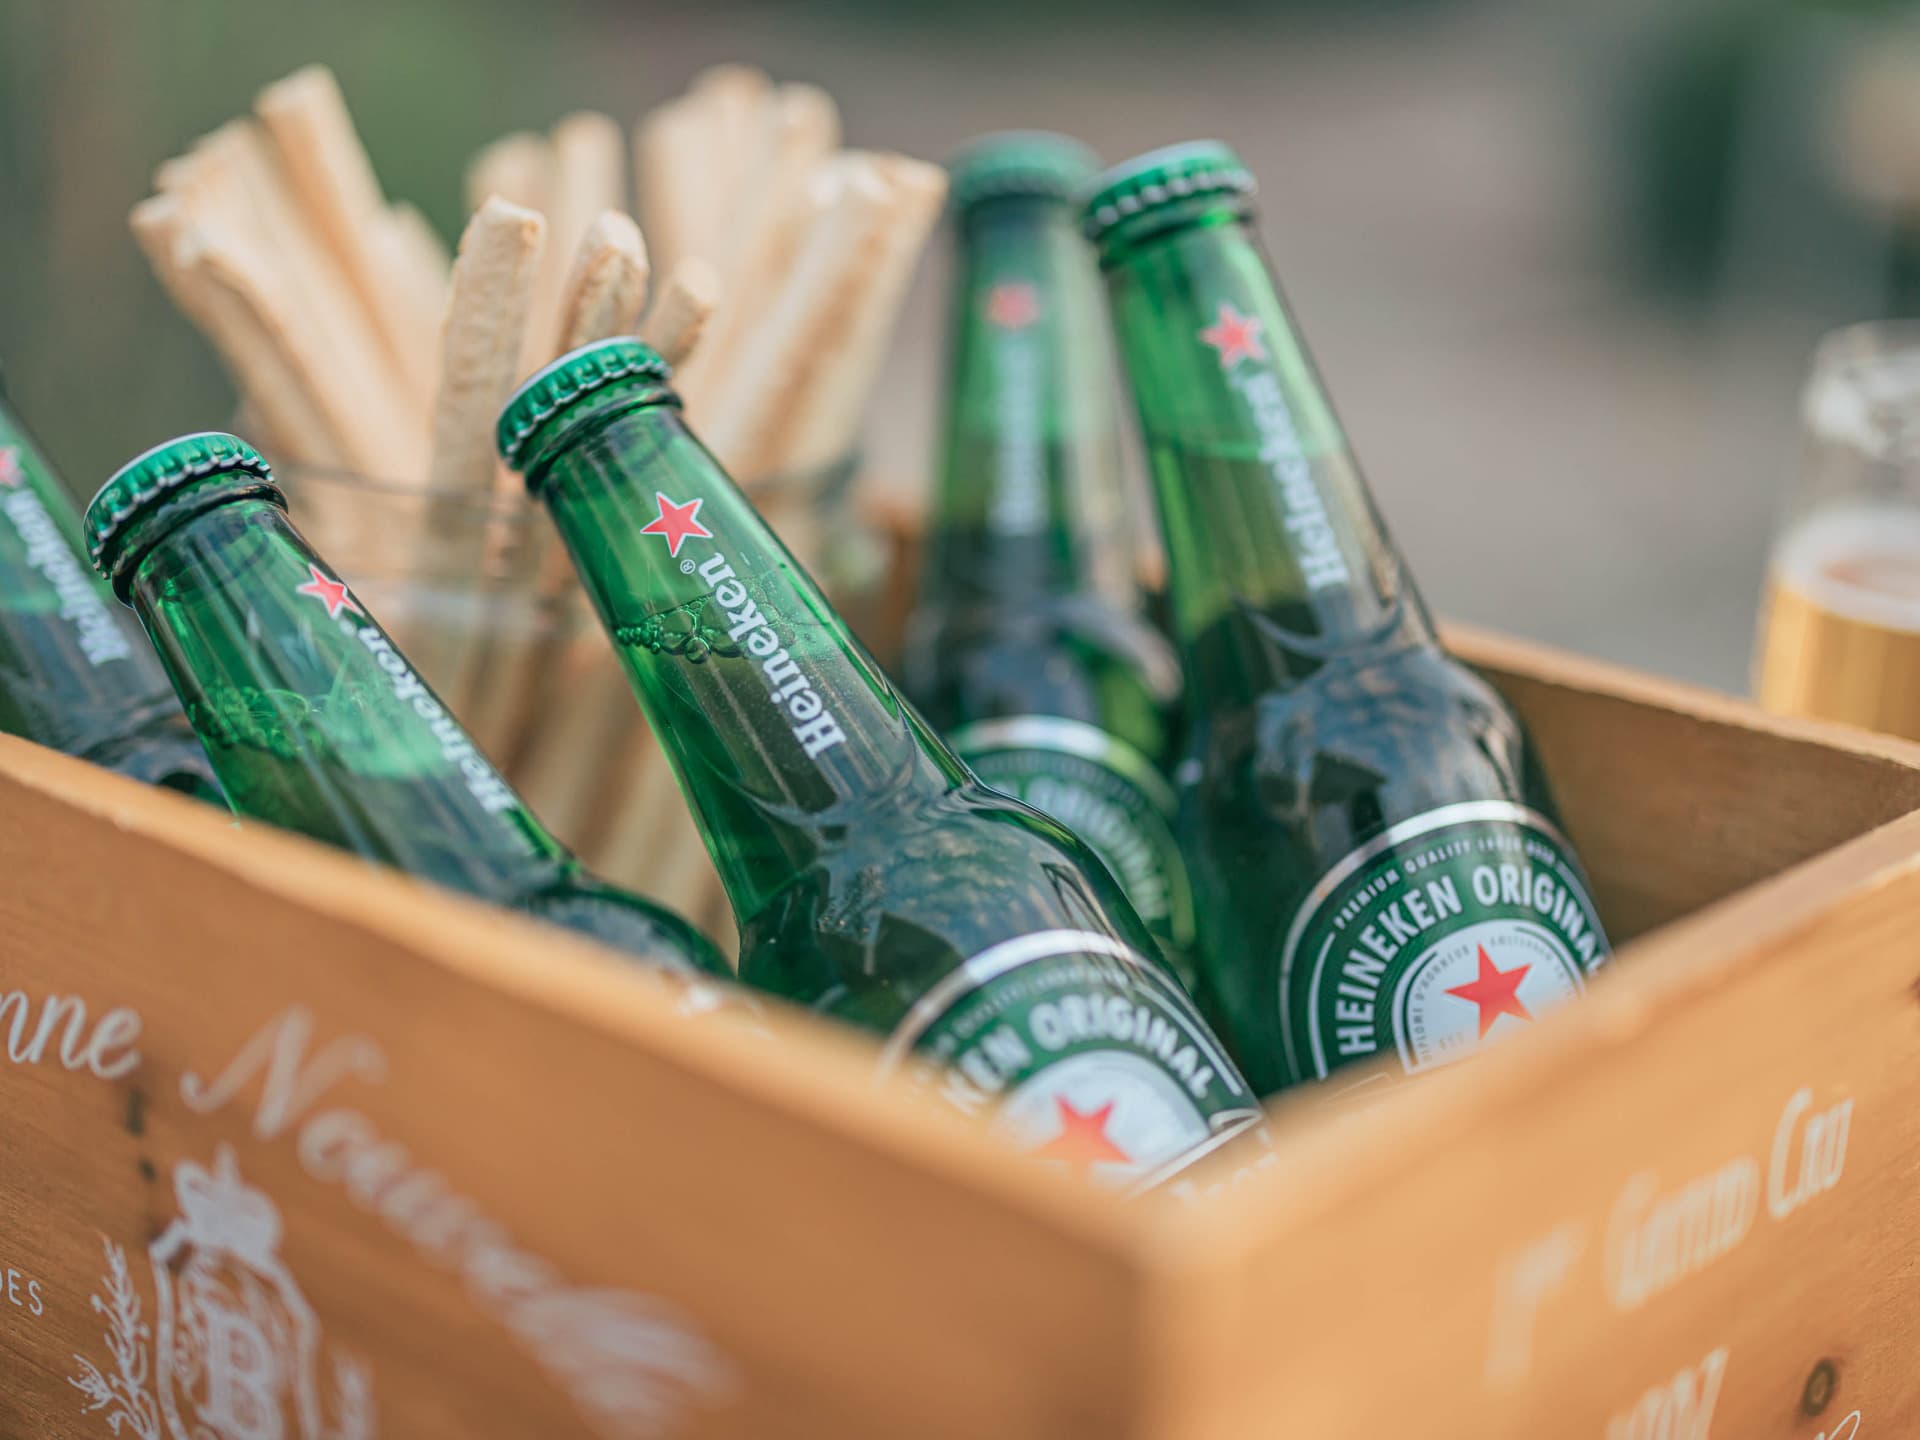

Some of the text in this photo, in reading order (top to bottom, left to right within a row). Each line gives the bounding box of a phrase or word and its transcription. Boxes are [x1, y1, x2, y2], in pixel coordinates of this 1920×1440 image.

[357, 626, 516, 814] Heineken
[697, 552, 847, 760] Heineken
[1333, 868, 1400, 930] PREMIUM
[1403, 839, 1470, 874] QUALITY
[1335, 874, 1464, 1056] HEINEKEN
[1027, 993, 1215, 1099] ORIGINAL
